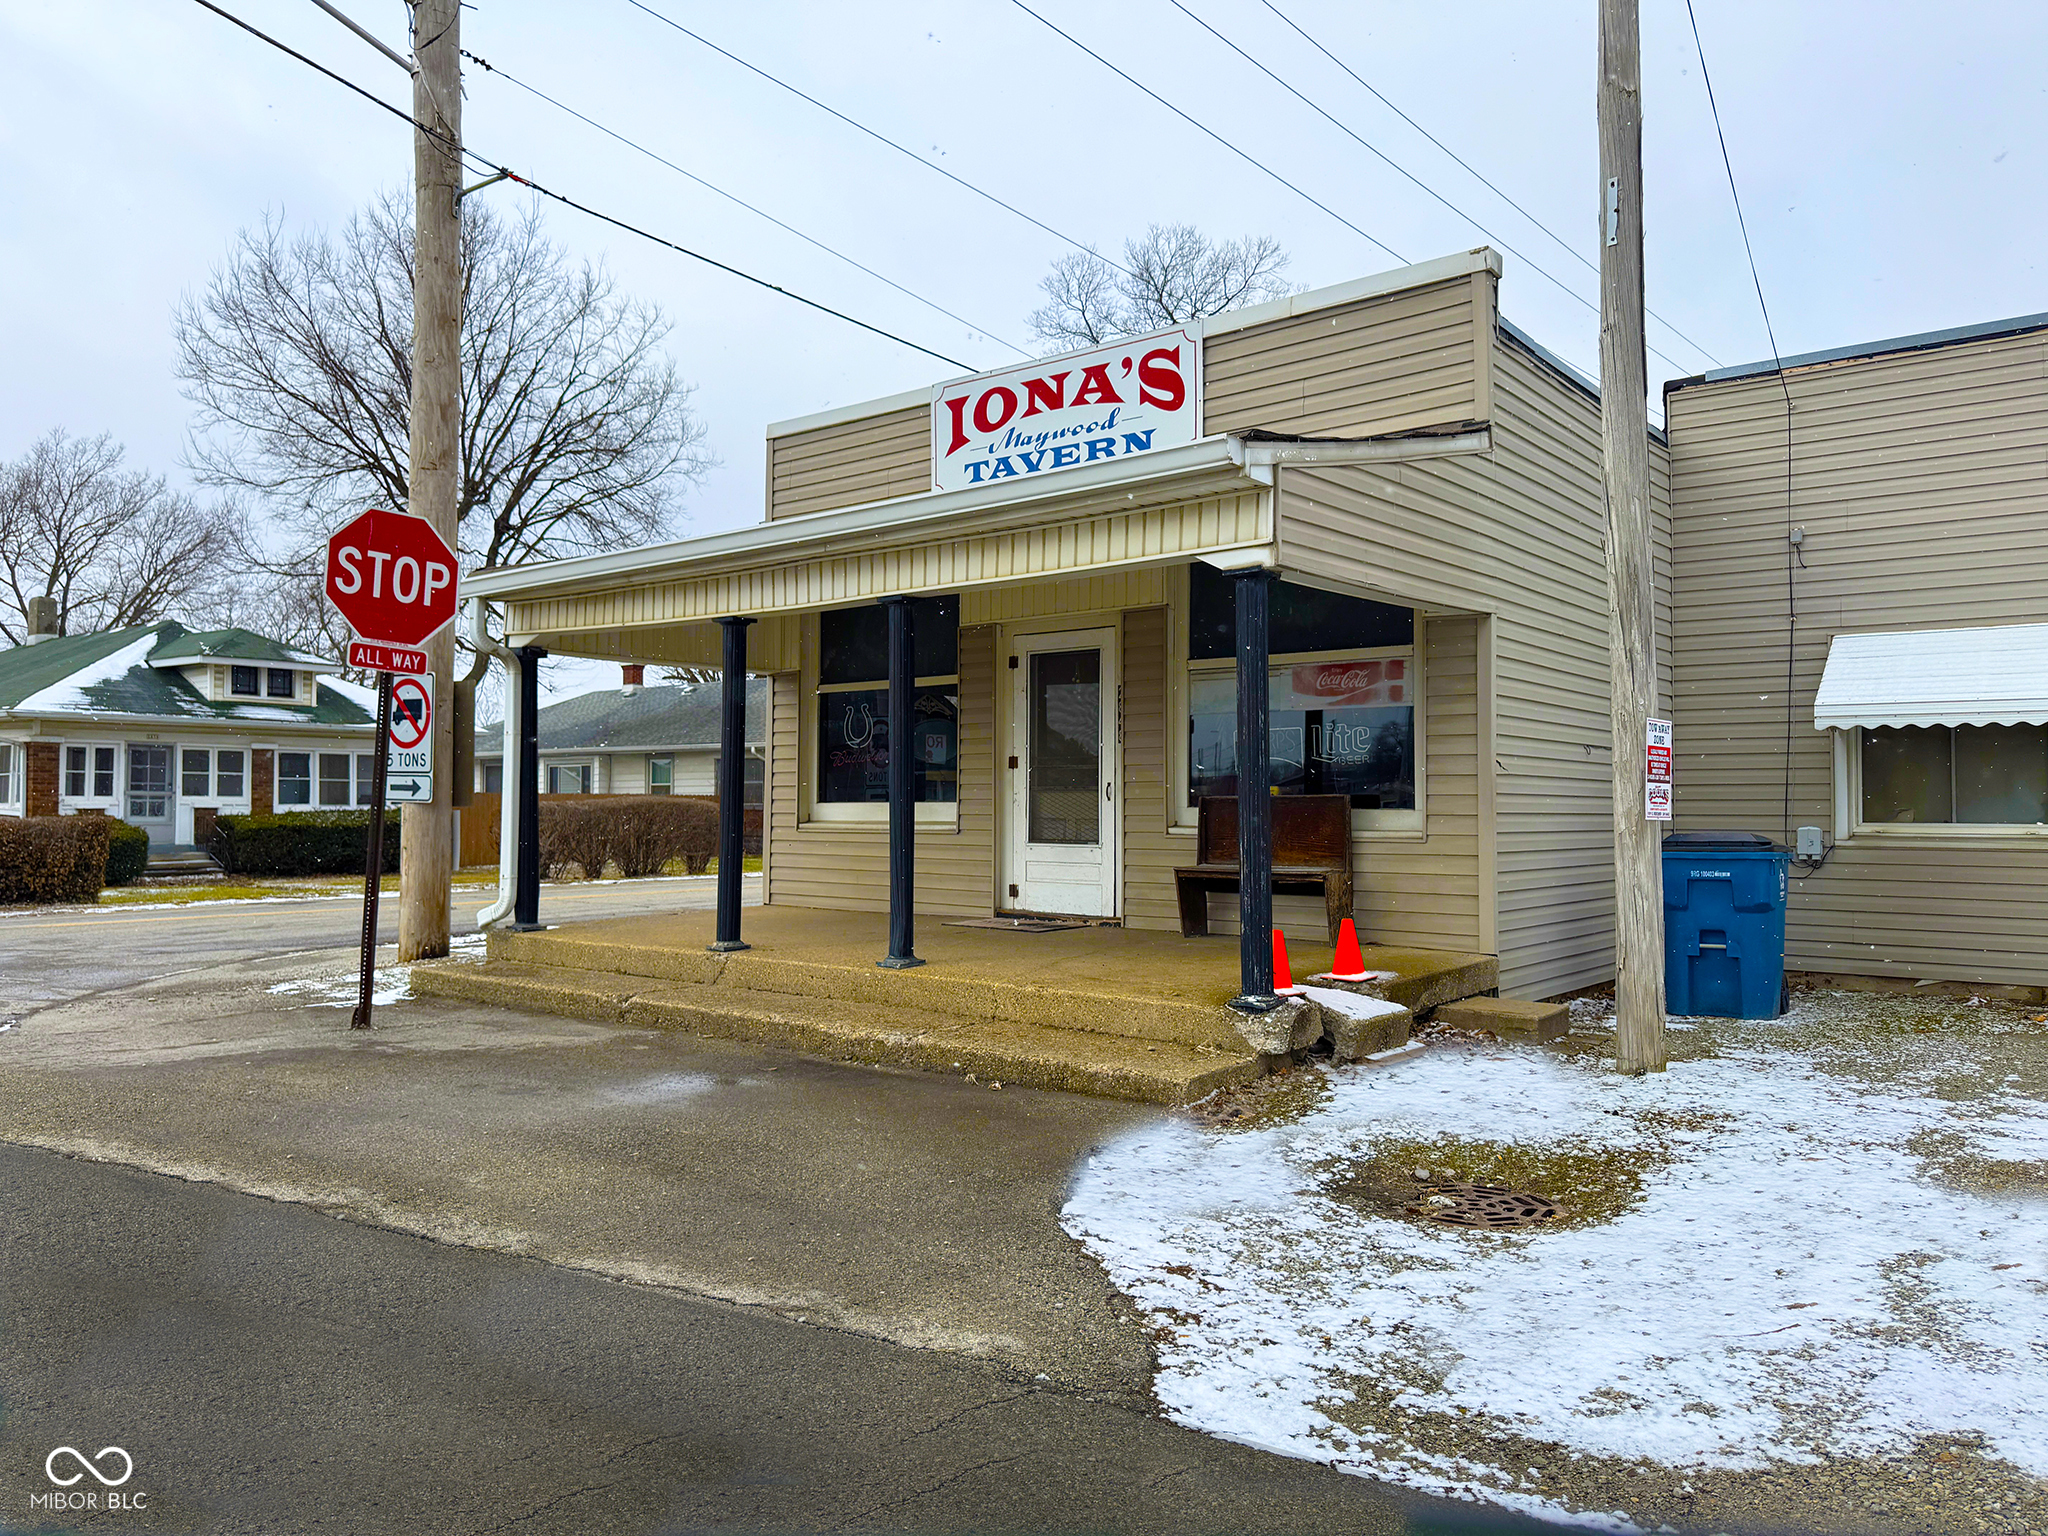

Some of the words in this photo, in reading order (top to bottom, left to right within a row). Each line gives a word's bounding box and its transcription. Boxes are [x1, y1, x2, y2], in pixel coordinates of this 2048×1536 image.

[944, 345, 1186, 459] IONA'S
[988, 407, 1121, 455] Maywood
[963, 427, 1158, 484] TAVERN
[335, 545, 450, 607] STOP
[355, 648, 384, 667] ALL
[392, 651, 422, 670] WAY
[1316, 669, 1371, 690] Coca-Cola
[398, 752, 427, 767] TONS
[1311, 722, 1372, 763] Lite
